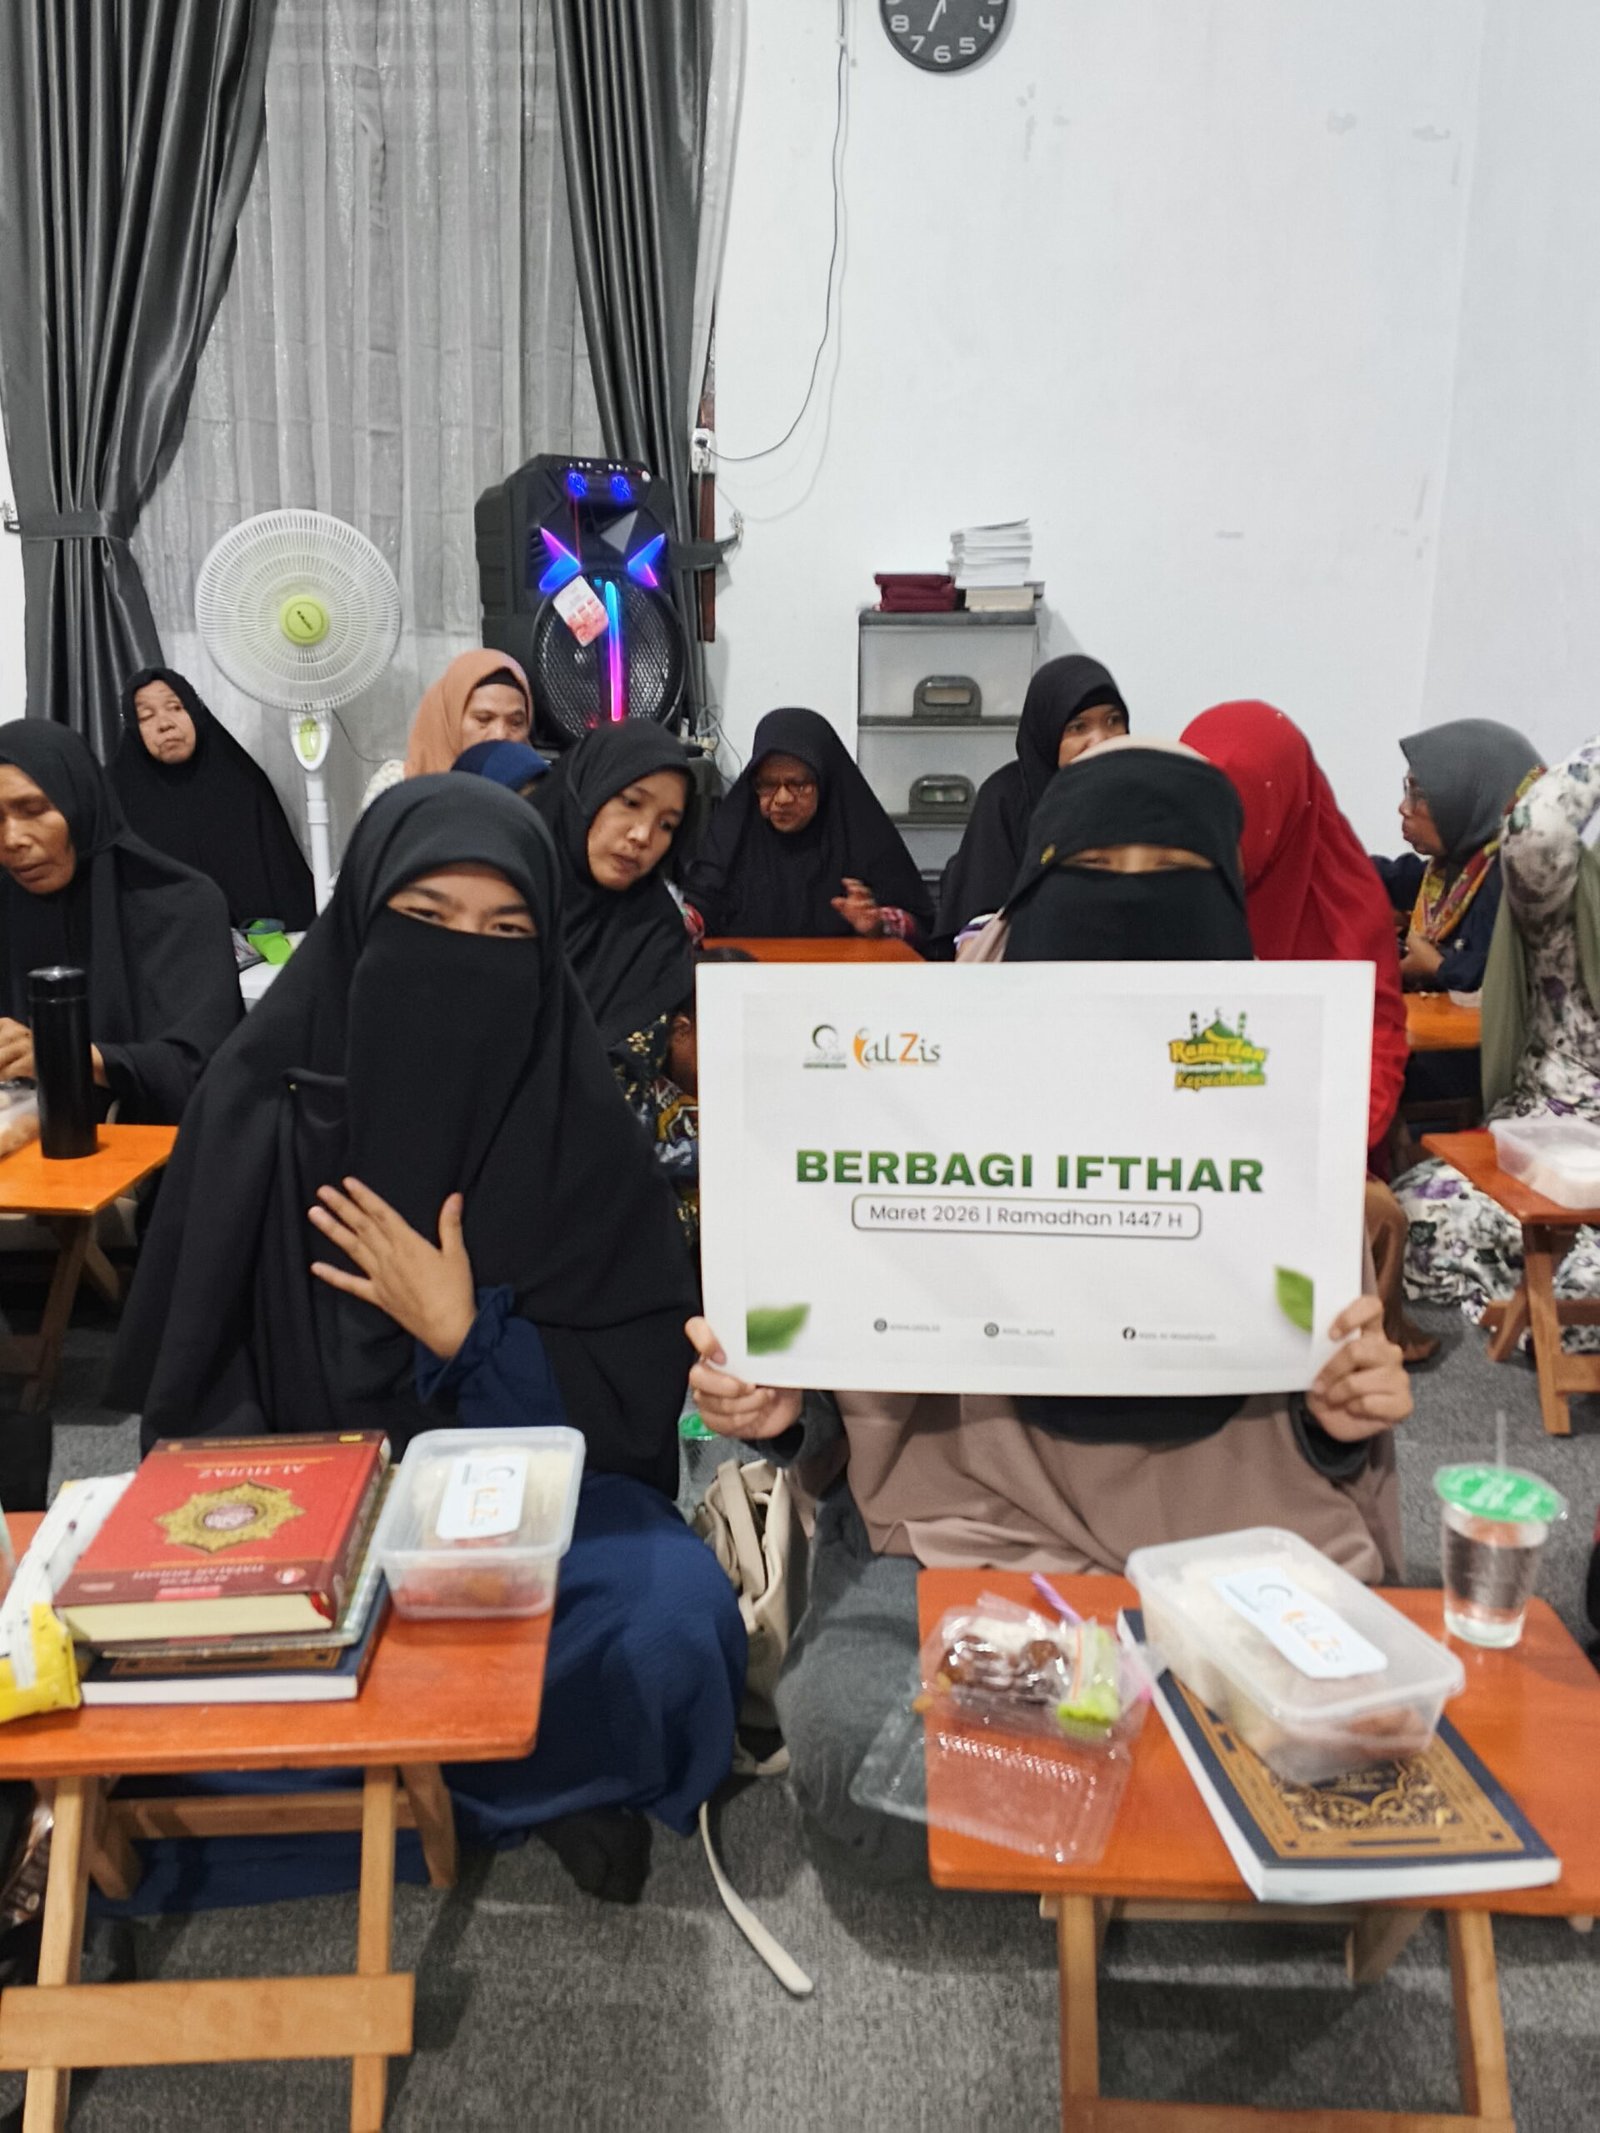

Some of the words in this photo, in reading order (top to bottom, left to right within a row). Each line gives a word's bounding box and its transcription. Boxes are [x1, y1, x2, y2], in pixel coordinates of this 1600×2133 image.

[891, 14, 909, 33] 8
[979, 15, 995, 33] 4
[910, 35, 925, 53] 7
[959, 36, 977, 55] 5
[933, 45, 951, 63] 6
[796, 1149, 1033, 1188] BERBAGI
[1057, 1155, 1263, 1193] IFTHAR
[869, 1204, 926, 1221] Maret
[933, 1206, 980, 1223] 2026
[997, 1206, 1112, 1226] Ramadhan
[1118, 1210, 1162, 1227] 1447
[1168, 1212, 1182, 1228] H
